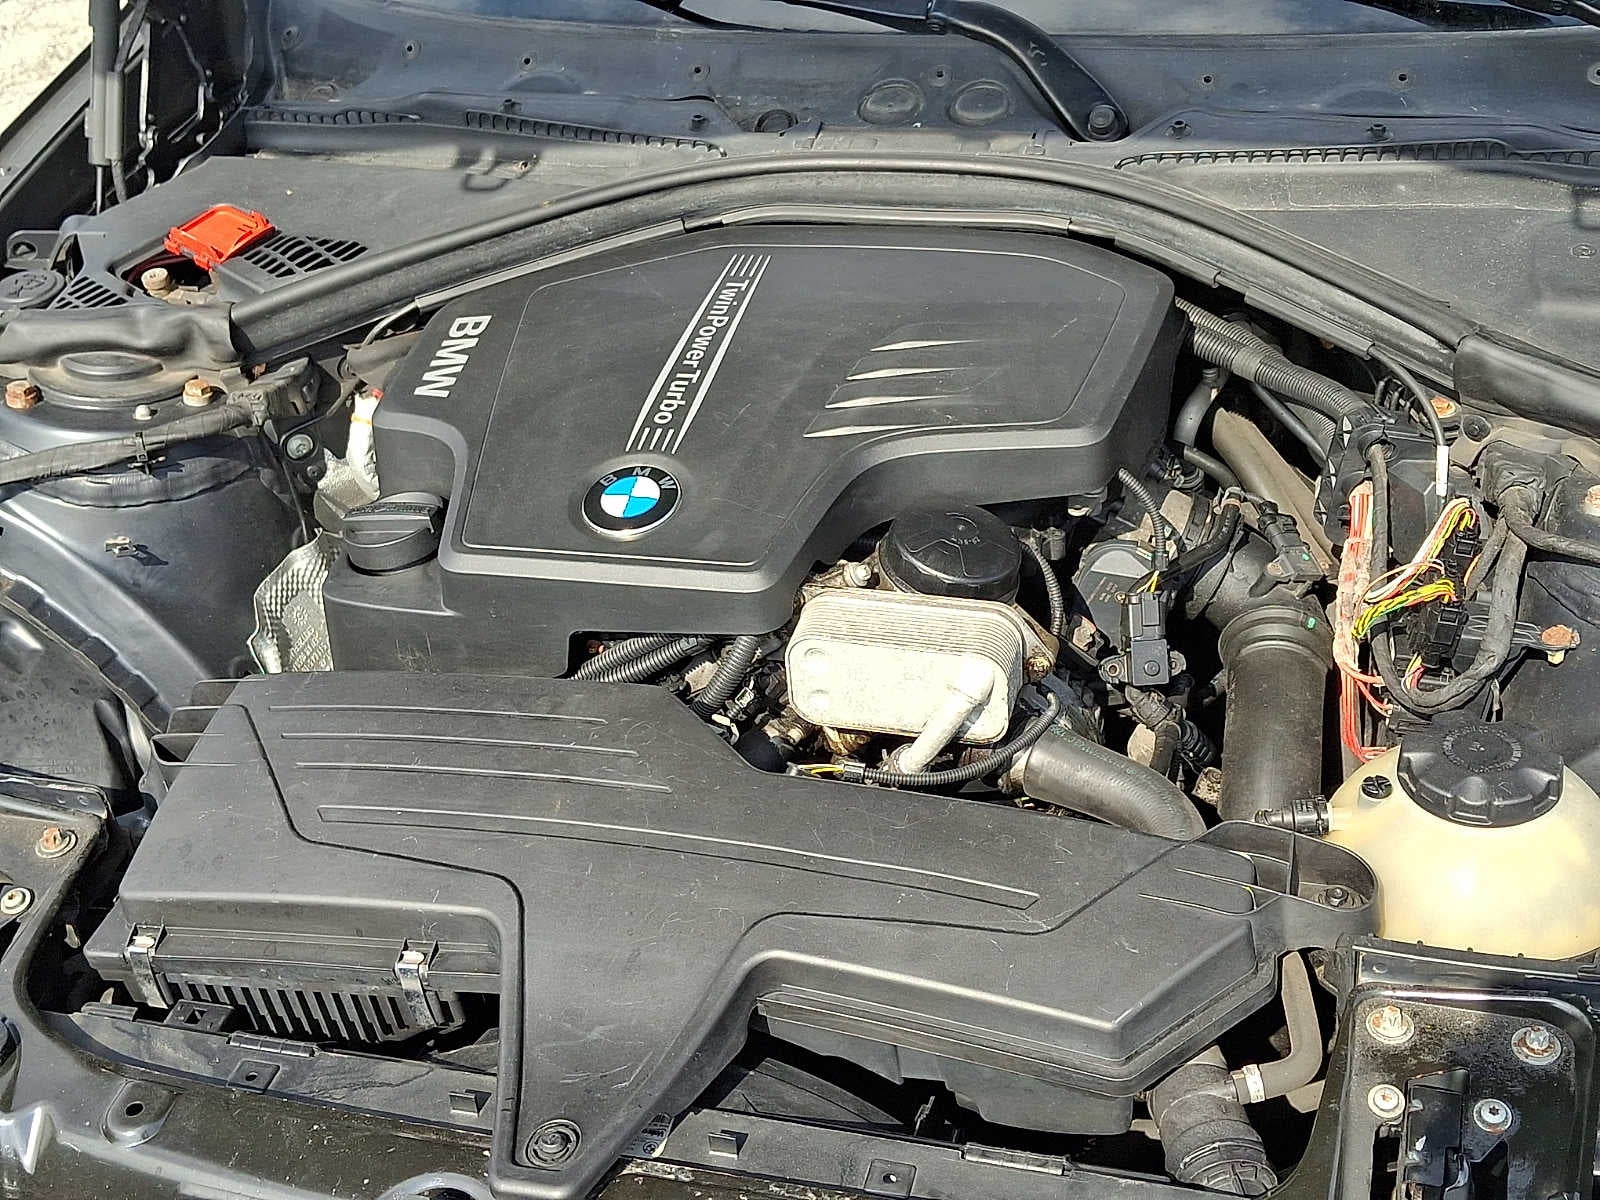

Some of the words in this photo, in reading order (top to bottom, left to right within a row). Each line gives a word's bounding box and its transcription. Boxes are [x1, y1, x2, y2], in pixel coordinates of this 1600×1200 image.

[413, 315, 492, 398] BMW
[682, 279, 750, 369] TwinPower
[653, 369, 702, 424] Turbo
[600, 467, 677, 489] BMW
